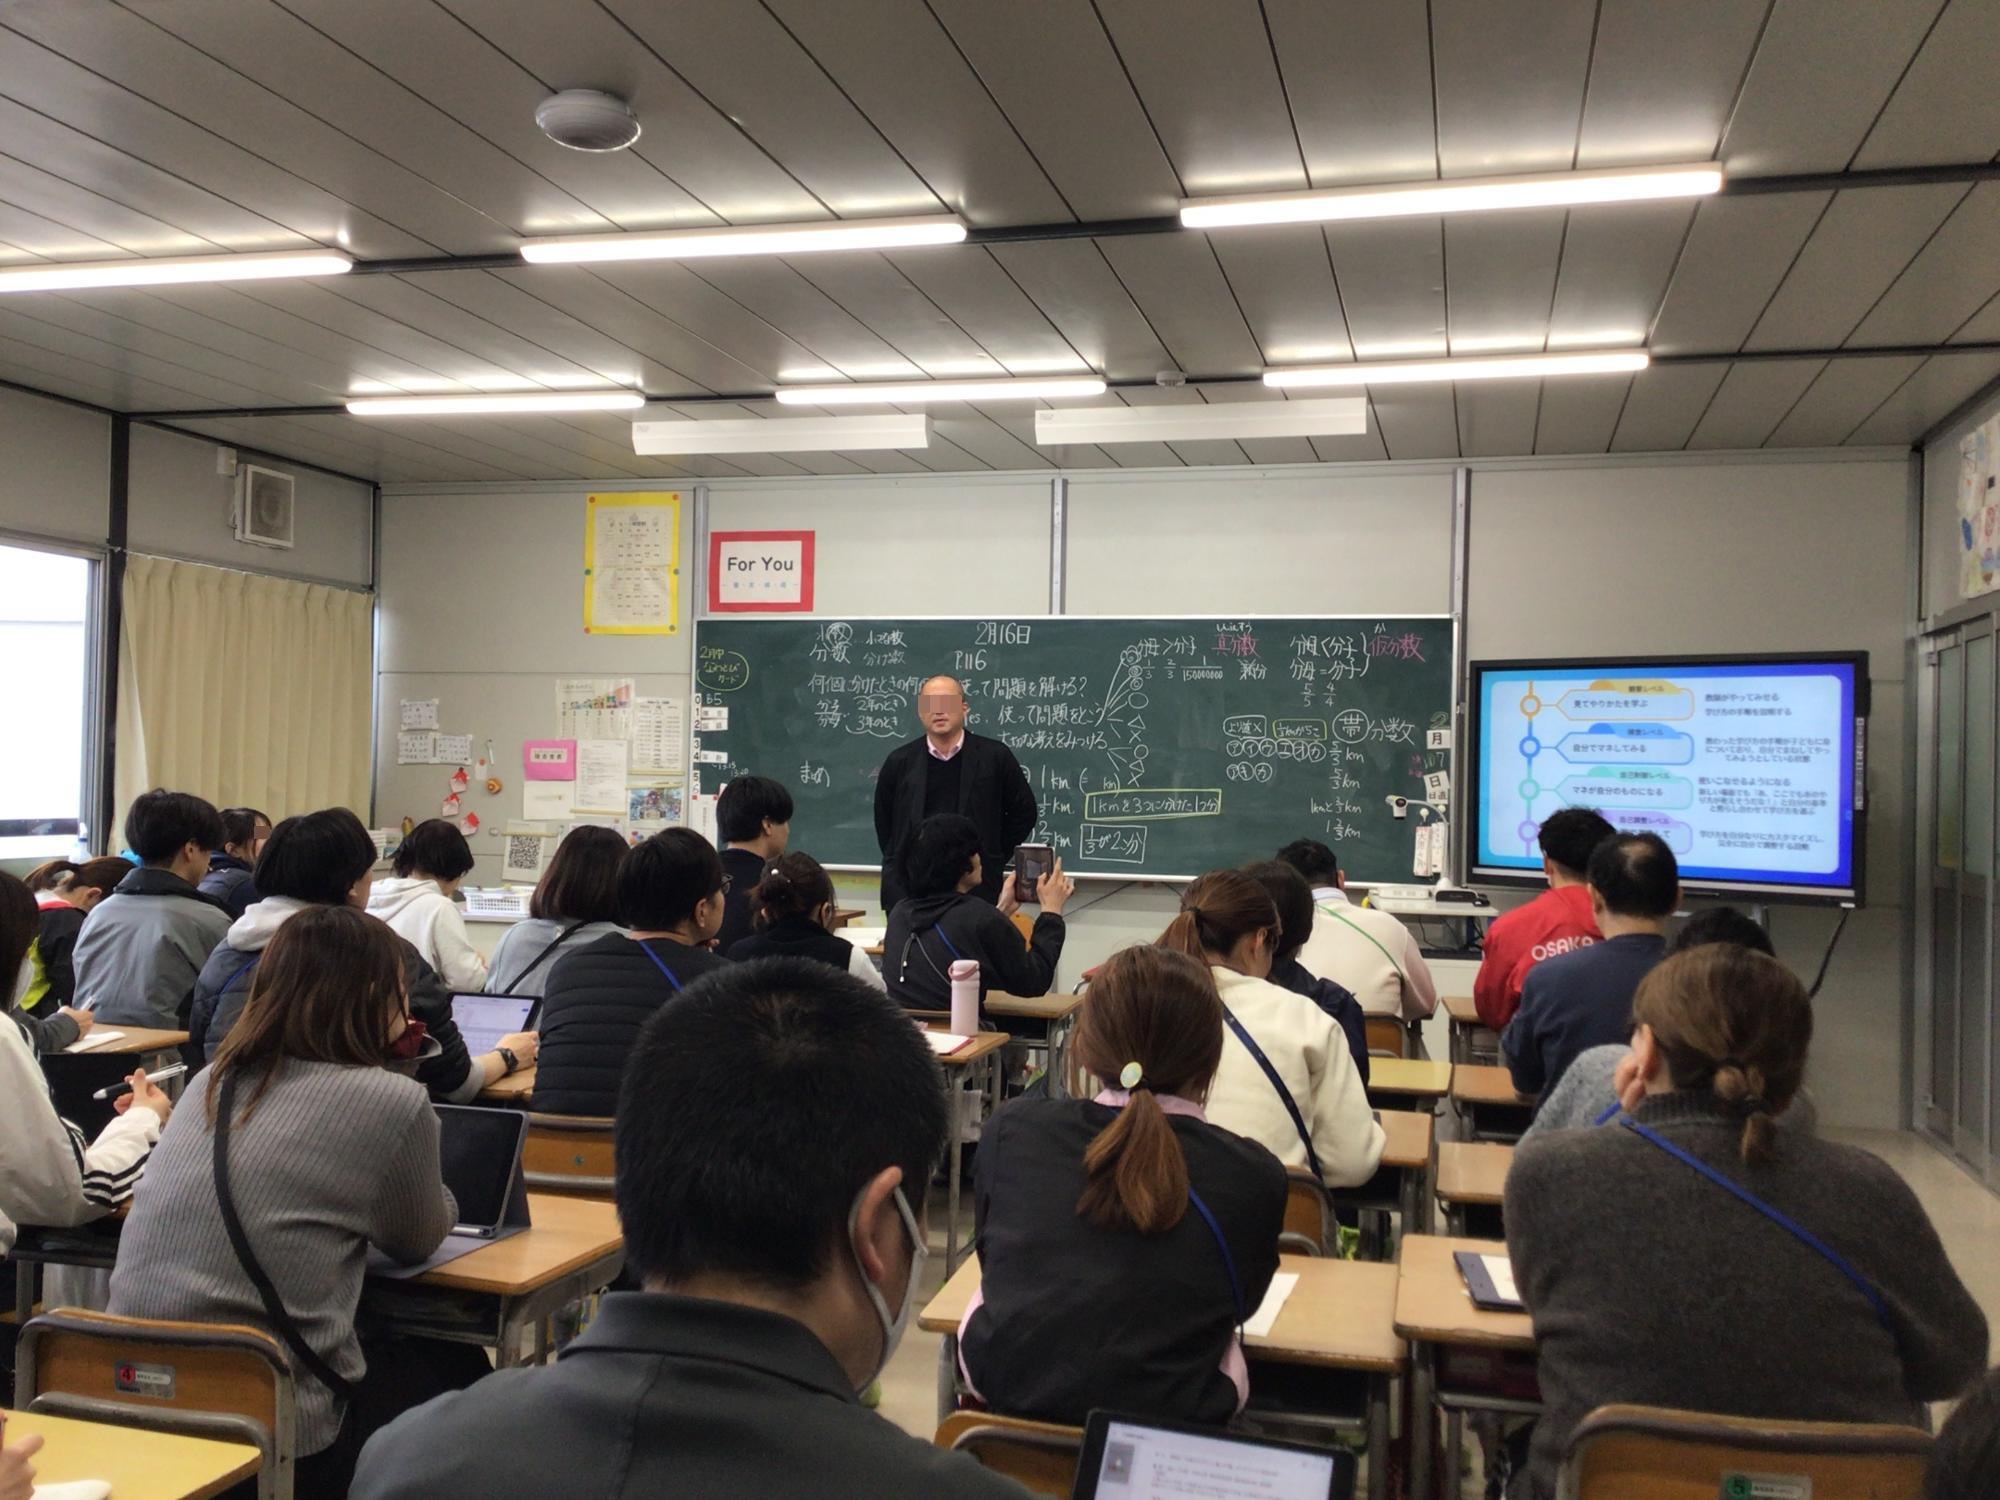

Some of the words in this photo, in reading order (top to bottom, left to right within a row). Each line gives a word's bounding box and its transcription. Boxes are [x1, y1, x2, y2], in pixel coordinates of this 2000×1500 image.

[728, 557, 756, 571] For
[761, 557, 794, 571] You
[975, 621, 1031, 645] 2月16日
[694, 720, 701, 729] 2
[694, 740, 699, 749] 3
[1432, 732, 1442, 745] 月
[693, 752, 699, 760] 4
[693, 773, 699, 782] 5
[1429, 775, 1441, 788] 日
[1531, 936, 1594, 961] OSAKA
